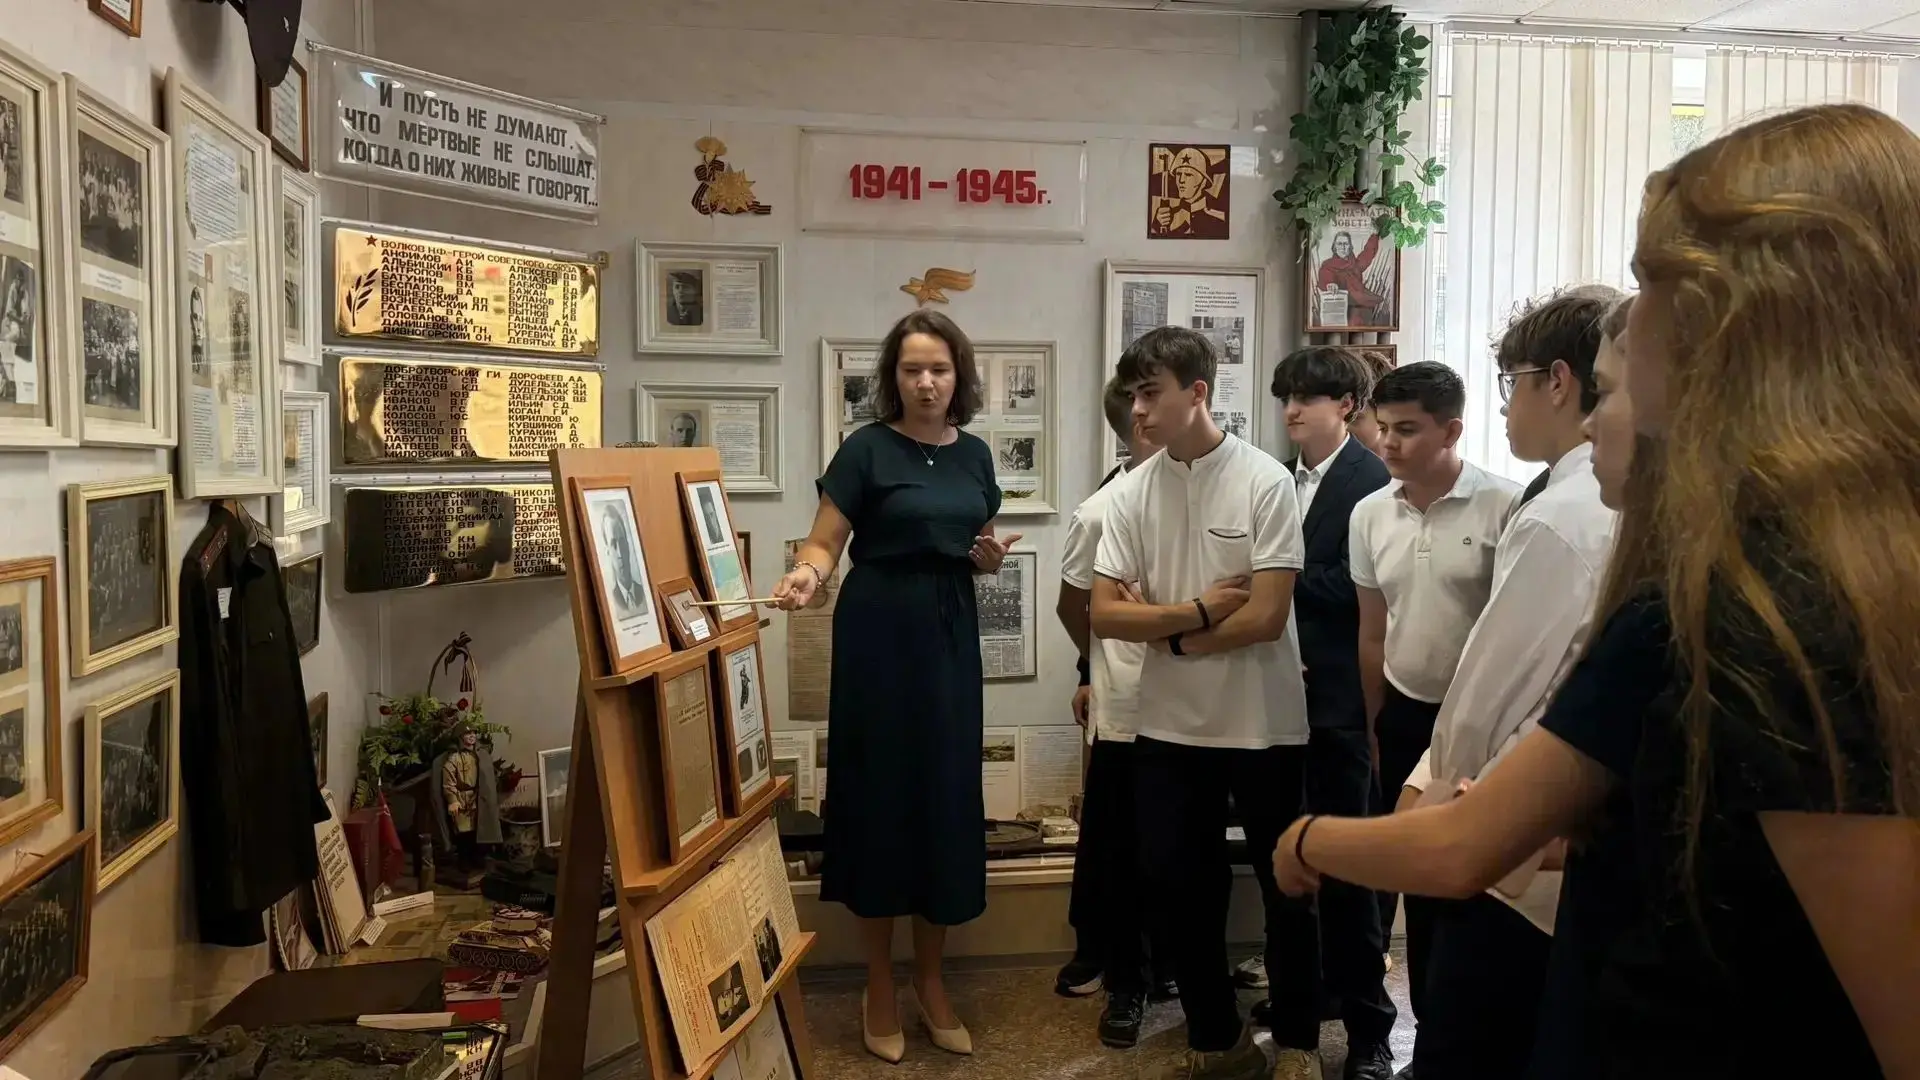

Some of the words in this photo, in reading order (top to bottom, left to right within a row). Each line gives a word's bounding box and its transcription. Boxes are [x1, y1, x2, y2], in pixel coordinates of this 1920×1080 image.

[380, 81, 392, 108] И
[403, 91, 460, 124] ПУСТЬ
[466, 107, 487, 130] НЕ
[344, 108, 380, 134] ЧТО
[399, 120, 480, 157] МЕРТВЫЕ
[494, 141, 512, 163] НЕ
[344, 138, 403, 170] КОГДА
[408, 151, 420, 172] О
[424, 154, 455, 180] НИХ
[461, 162, 520, 192] ЖИВЫЕ
[381, 240, 425, 253] ВОЛКОВ
[381, 249, 441, 263] АНФИМОВ
[382, 264, 443, 278] АНТРОПОВ
[381, 272, 436, 284] БАТУНИН
[381, 280, 444, 292] БЕСПАЛОВ
[381, 302, 434, 314] ГАГАЕВА
[508, 329, 553, 340] ГУРЕВИЧ
[508, 337, 556, 347] ДЕВЯТЫХ
[383, 389, 440, 398] ЕФРЕМОВ
[384, 397, 430, 405] ИВАНОВ
[508, 400, 543, 408] ИЛЬИН
[384, 404, 436, 412] КАРДАШ
[384, 412, 436, 420] КОЛОСОВ
[514, 511, 560, 519] РОГУЛИ
